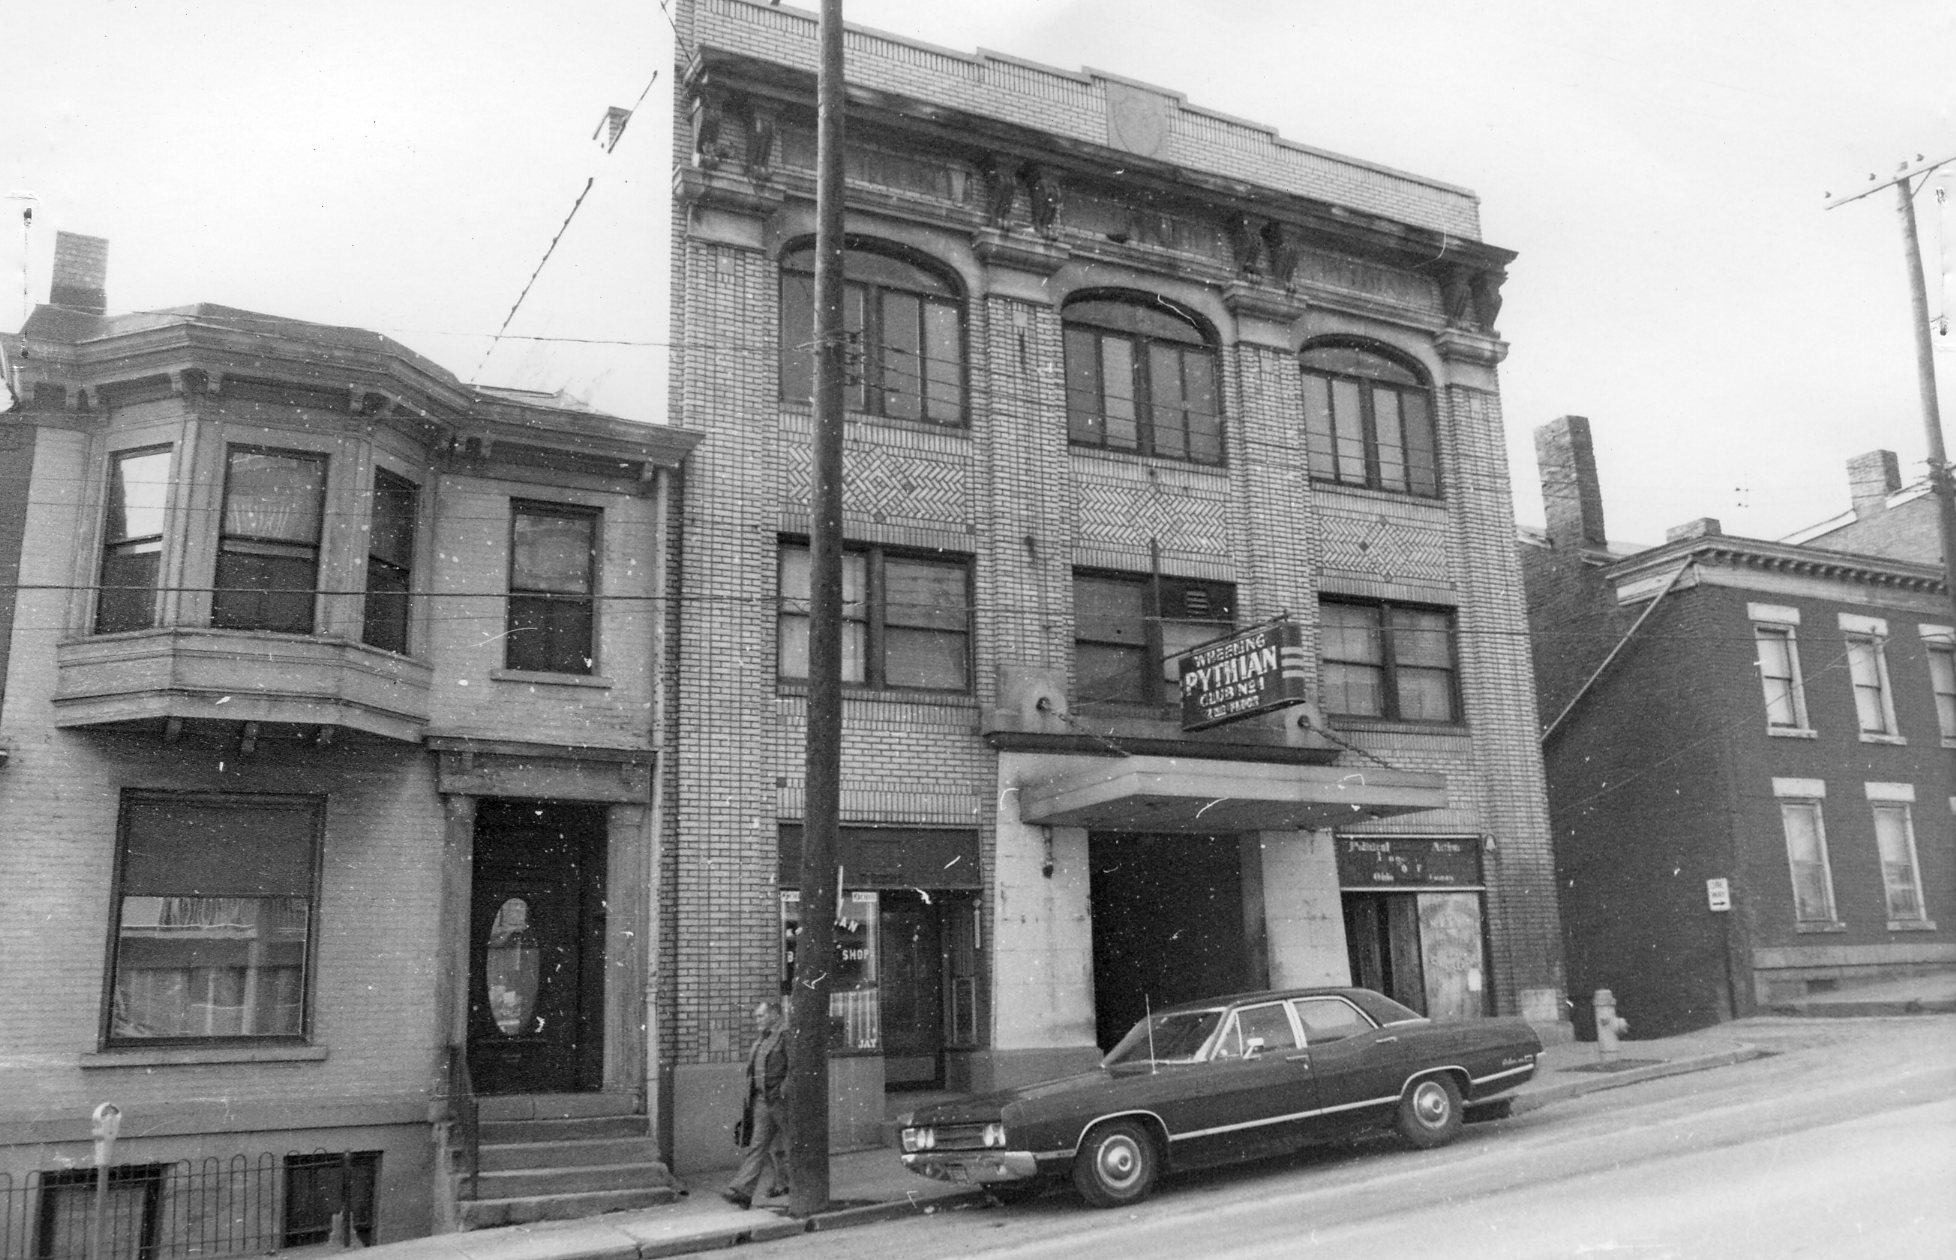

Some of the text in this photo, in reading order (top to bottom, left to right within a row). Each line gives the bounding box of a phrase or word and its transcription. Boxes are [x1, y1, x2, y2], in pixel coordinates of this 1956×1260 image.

[1193, 633, 1266, 668] WHEELING
[1185, 644, 1278, 697] PYTHIAN
[1200, 685, 1235, 708] CLUB
[842, 948, 869, 961] SHOP
